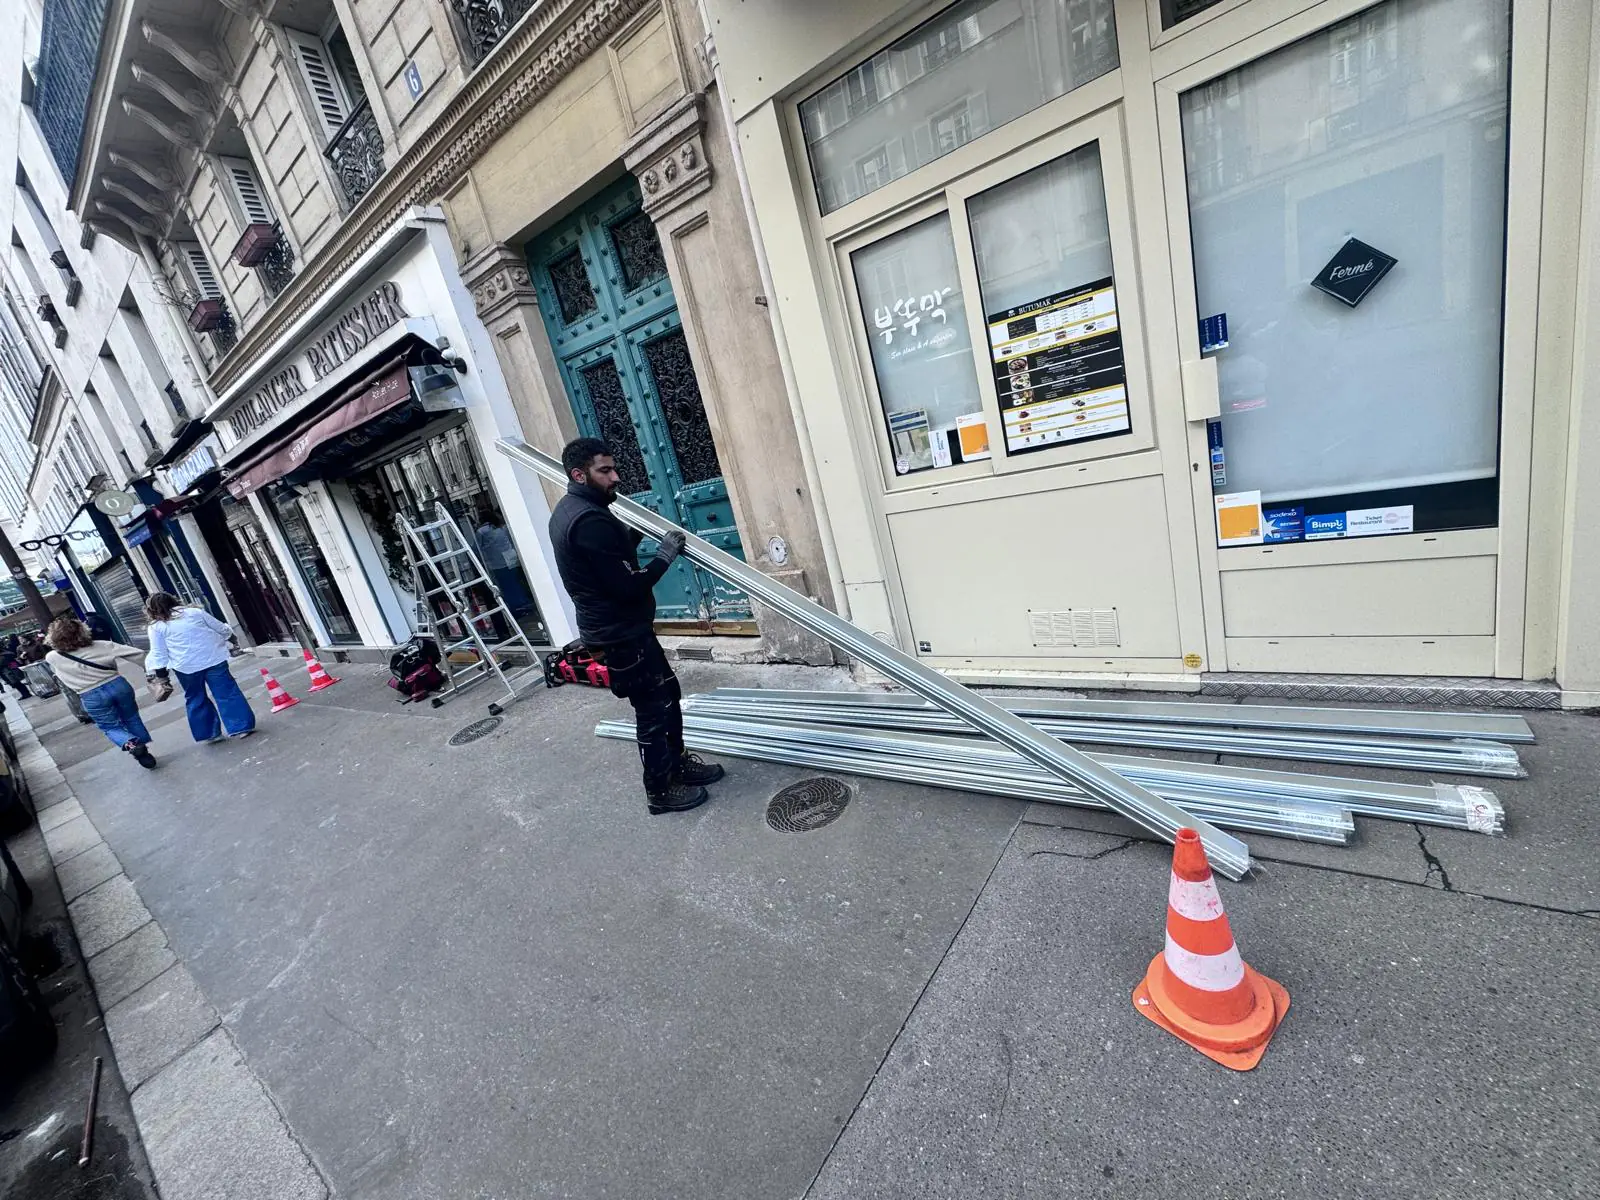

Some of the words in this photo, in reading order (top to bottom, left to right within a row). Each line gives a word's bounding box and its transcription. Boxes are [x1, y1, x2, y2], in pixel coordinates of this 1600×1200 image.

[409, 68, 419, 92] 6
[1329, 259, 1374, 280] Fermé
[1018, 298, 1052, 315] BUTUMAK
[229, 364, 308, 441] BOULANGER
[306, 280, 409, 382] PATISSIER
